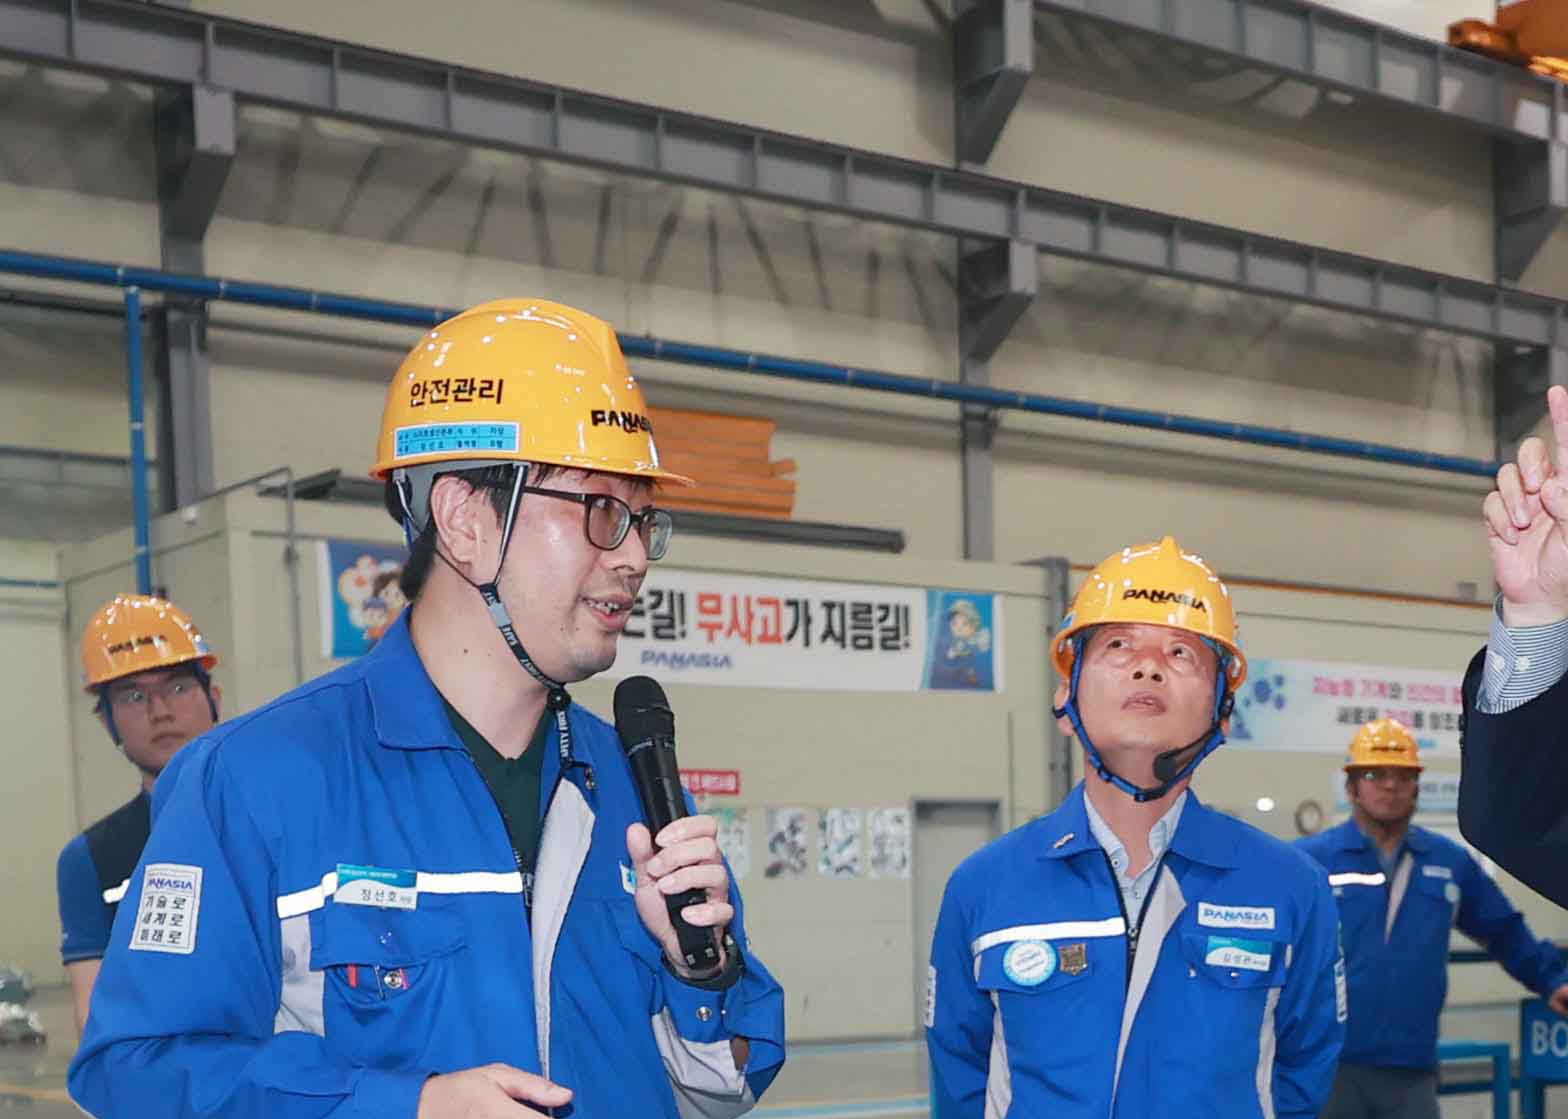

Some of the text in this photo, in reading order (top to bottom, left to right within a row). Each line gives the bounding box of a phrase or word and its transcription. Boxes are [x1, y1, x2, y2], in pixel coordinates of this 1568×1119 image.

[410, 377, 504, 408] 안전관리
[591, 410, 654, 434] PANAS
[696, 591, 812, 648] 무사고가
[820, 599, 911, 651] 지름길!
[640, 650, 734, 670] PANASIA
[1203, 907, 1270, 921] PANASIA
